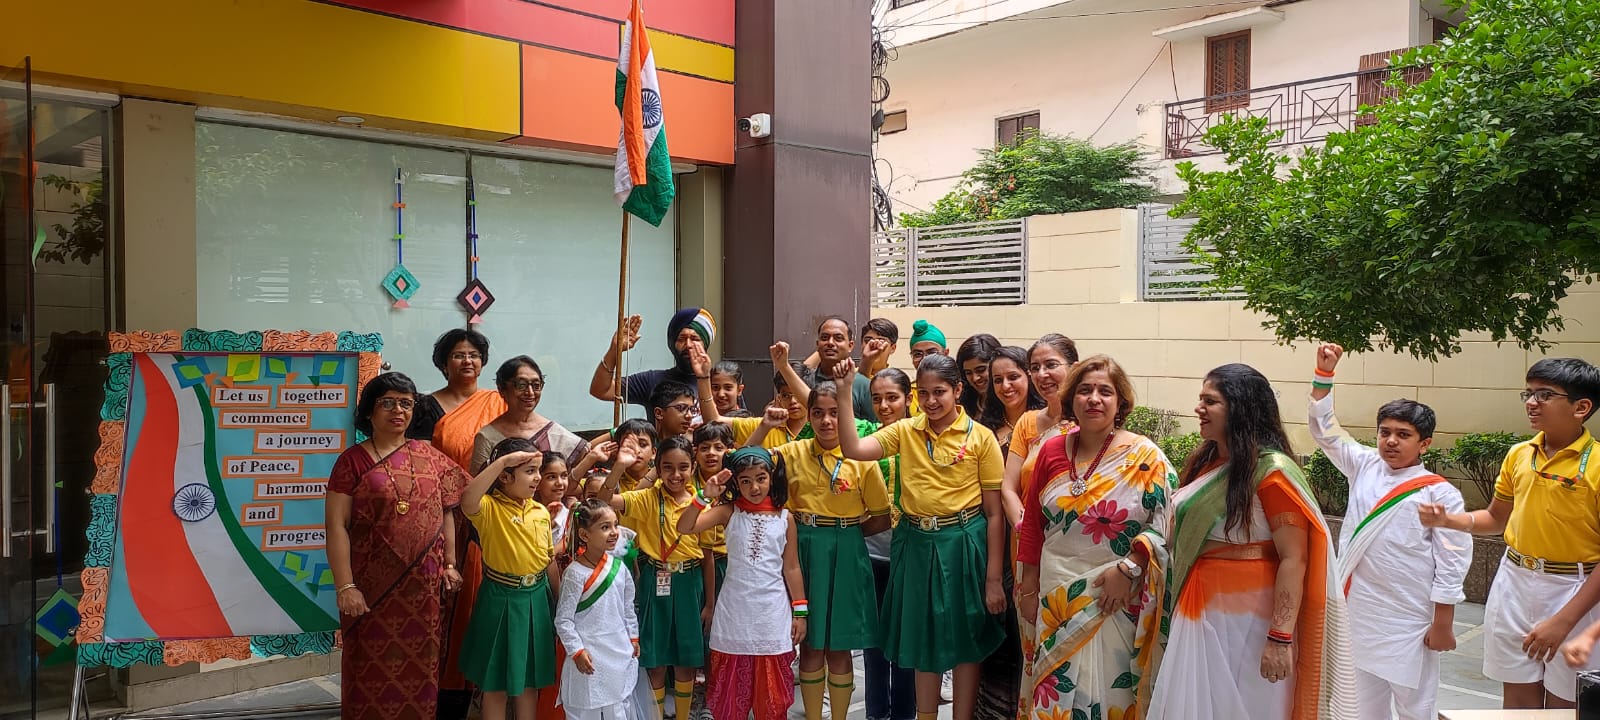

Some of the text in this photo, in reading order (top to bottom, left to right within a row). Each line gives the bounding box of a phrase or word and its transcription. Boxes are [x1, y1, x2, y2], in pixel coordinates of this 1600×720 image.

[220, 390, 342, 403] Let us together
[232, 413, 306, 424] commence
[266, 434, 333, 448] a journey
[231, 461, 295, 473] of Peace,
[248, 508, 276, 519] and
[269, 531, 325, 545] progres
